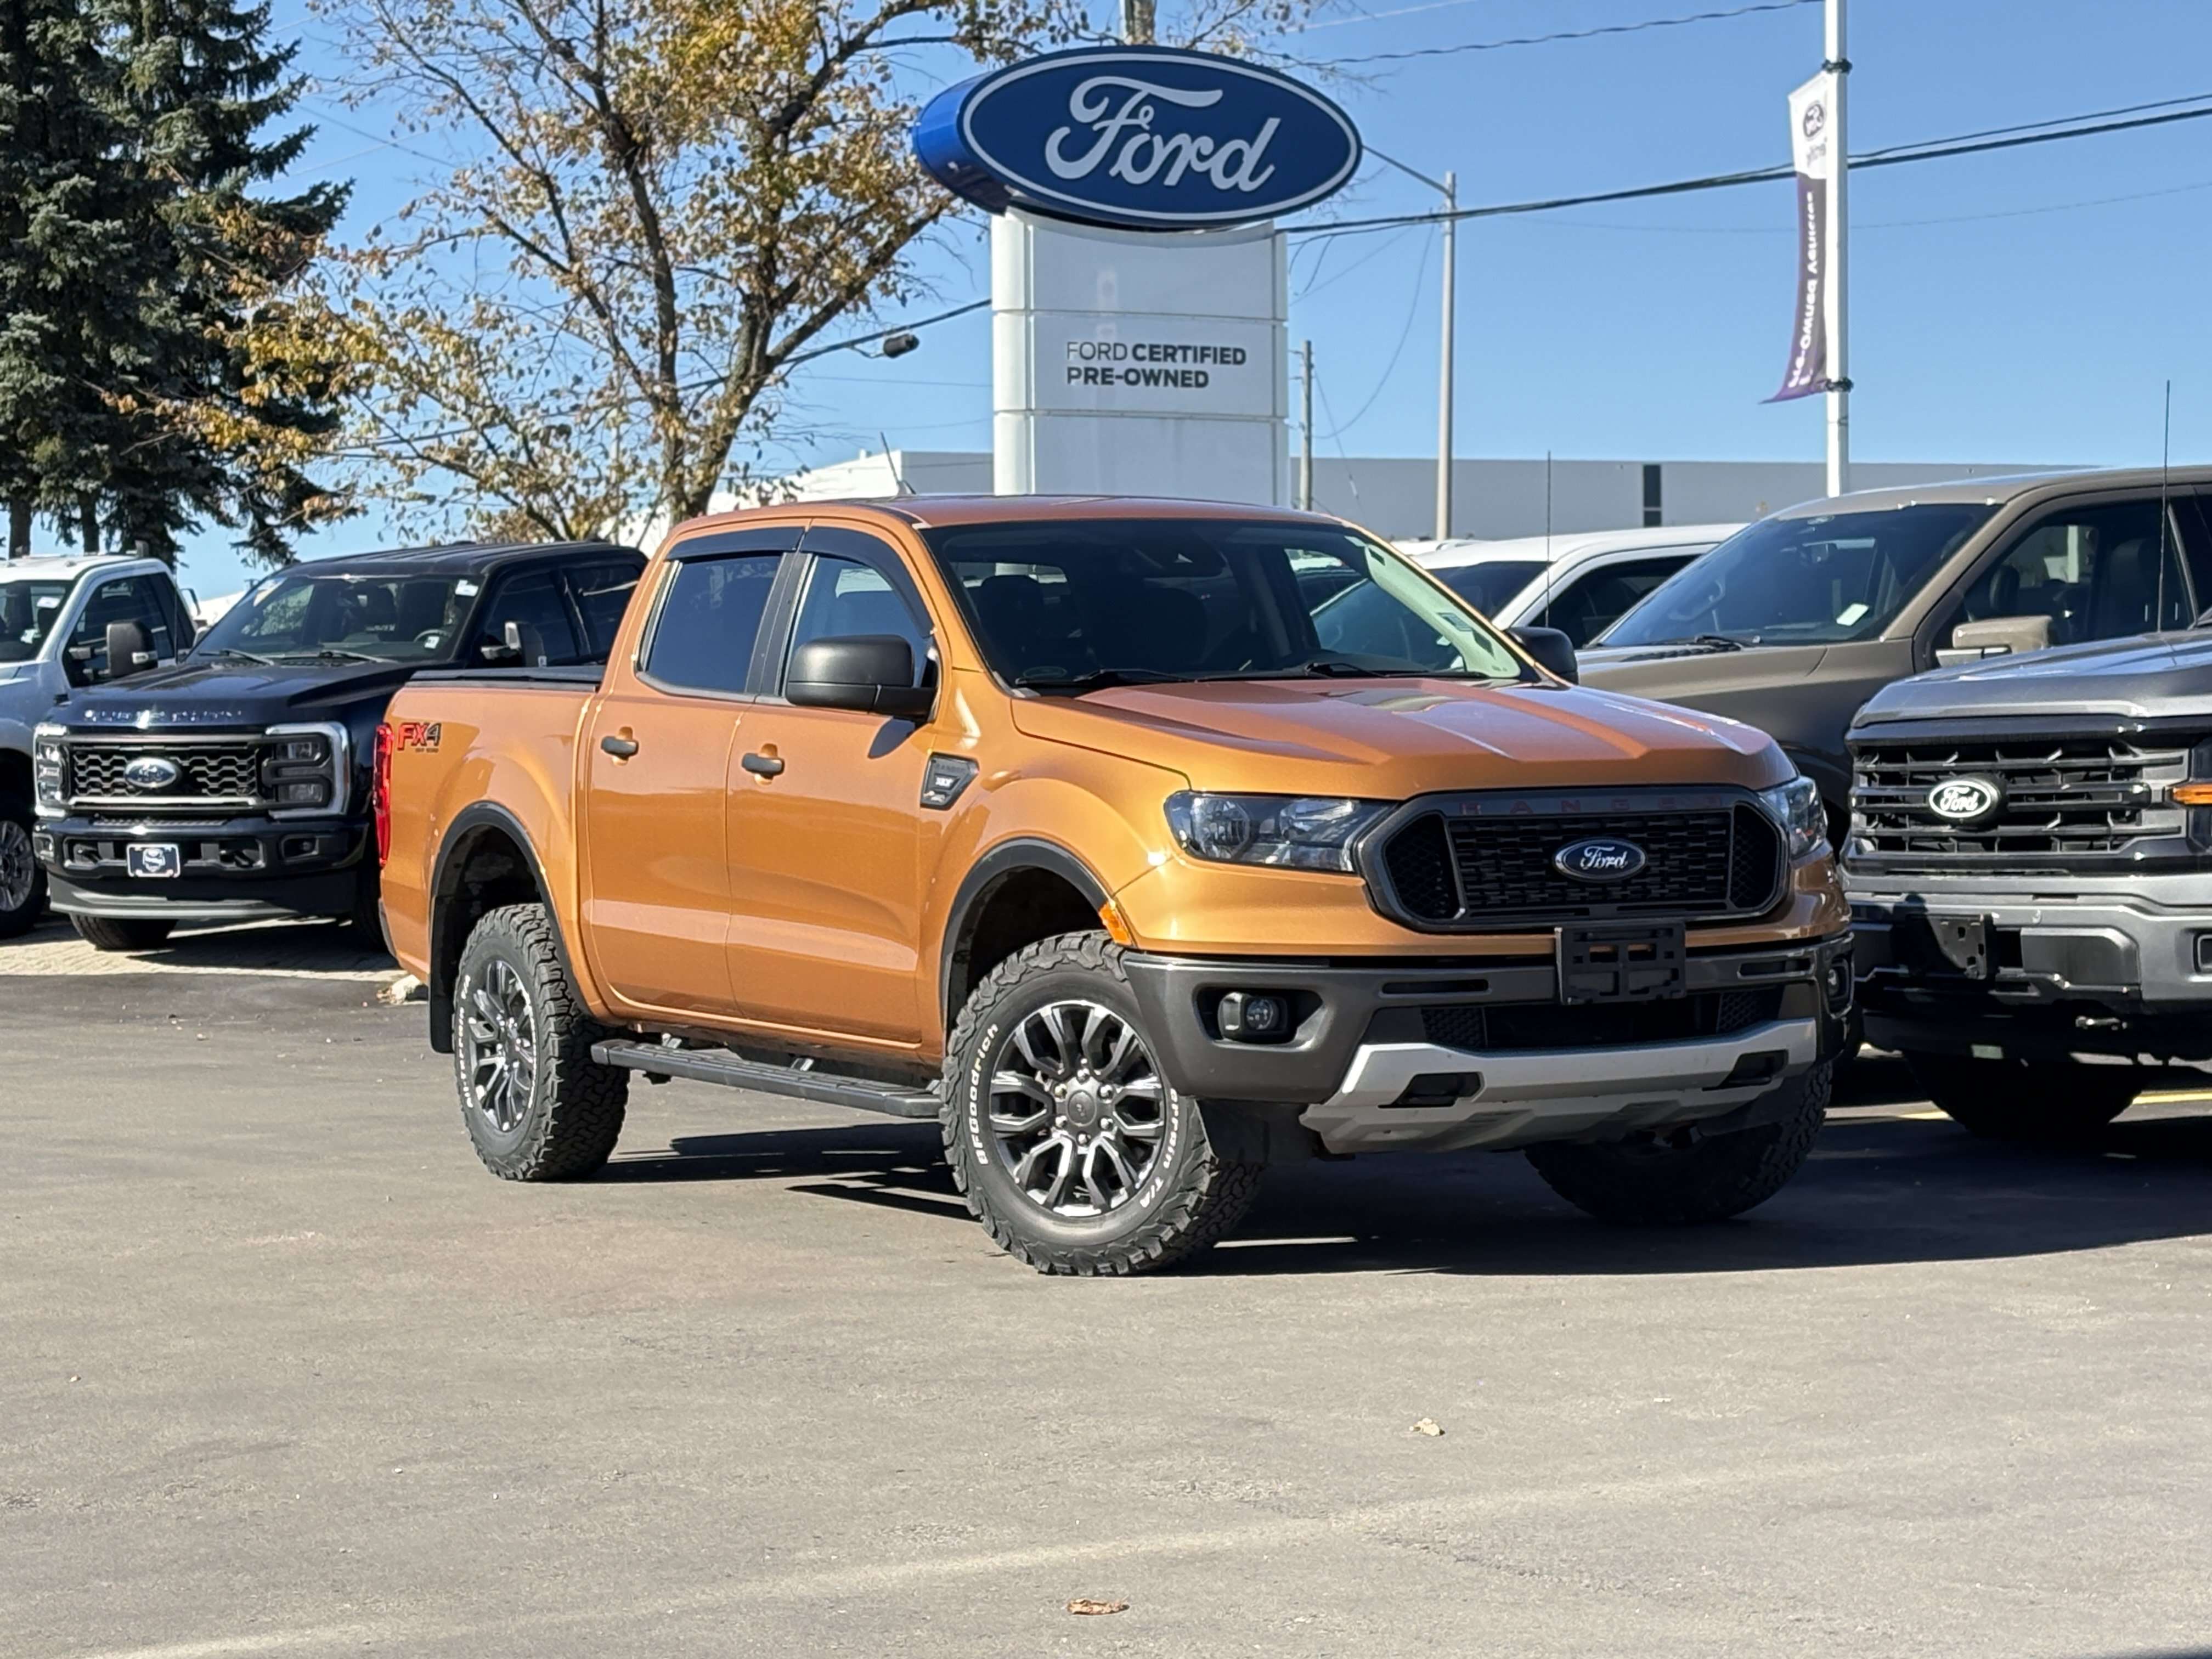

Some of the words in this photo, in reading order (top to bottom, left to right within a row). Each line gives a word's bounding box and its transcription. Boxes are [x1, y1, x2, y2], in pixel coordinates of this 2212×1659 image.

[1045, 76, 1281, 192] Ford
[1066, 342, 1127, 360] FORD
[1132, 343, 1246, 365] CERTIFIED
[1066, 366, 1209, 388] PRE-OWNED
[397, 722, 442, 751] FX4
[1940, 786, 1979, 811] Ford
[1579, 845, 1628, 870] Ford
[969, 1023, 998, 1165] BFGoodrich
[1164, 1088, 1179, 1169] errain
